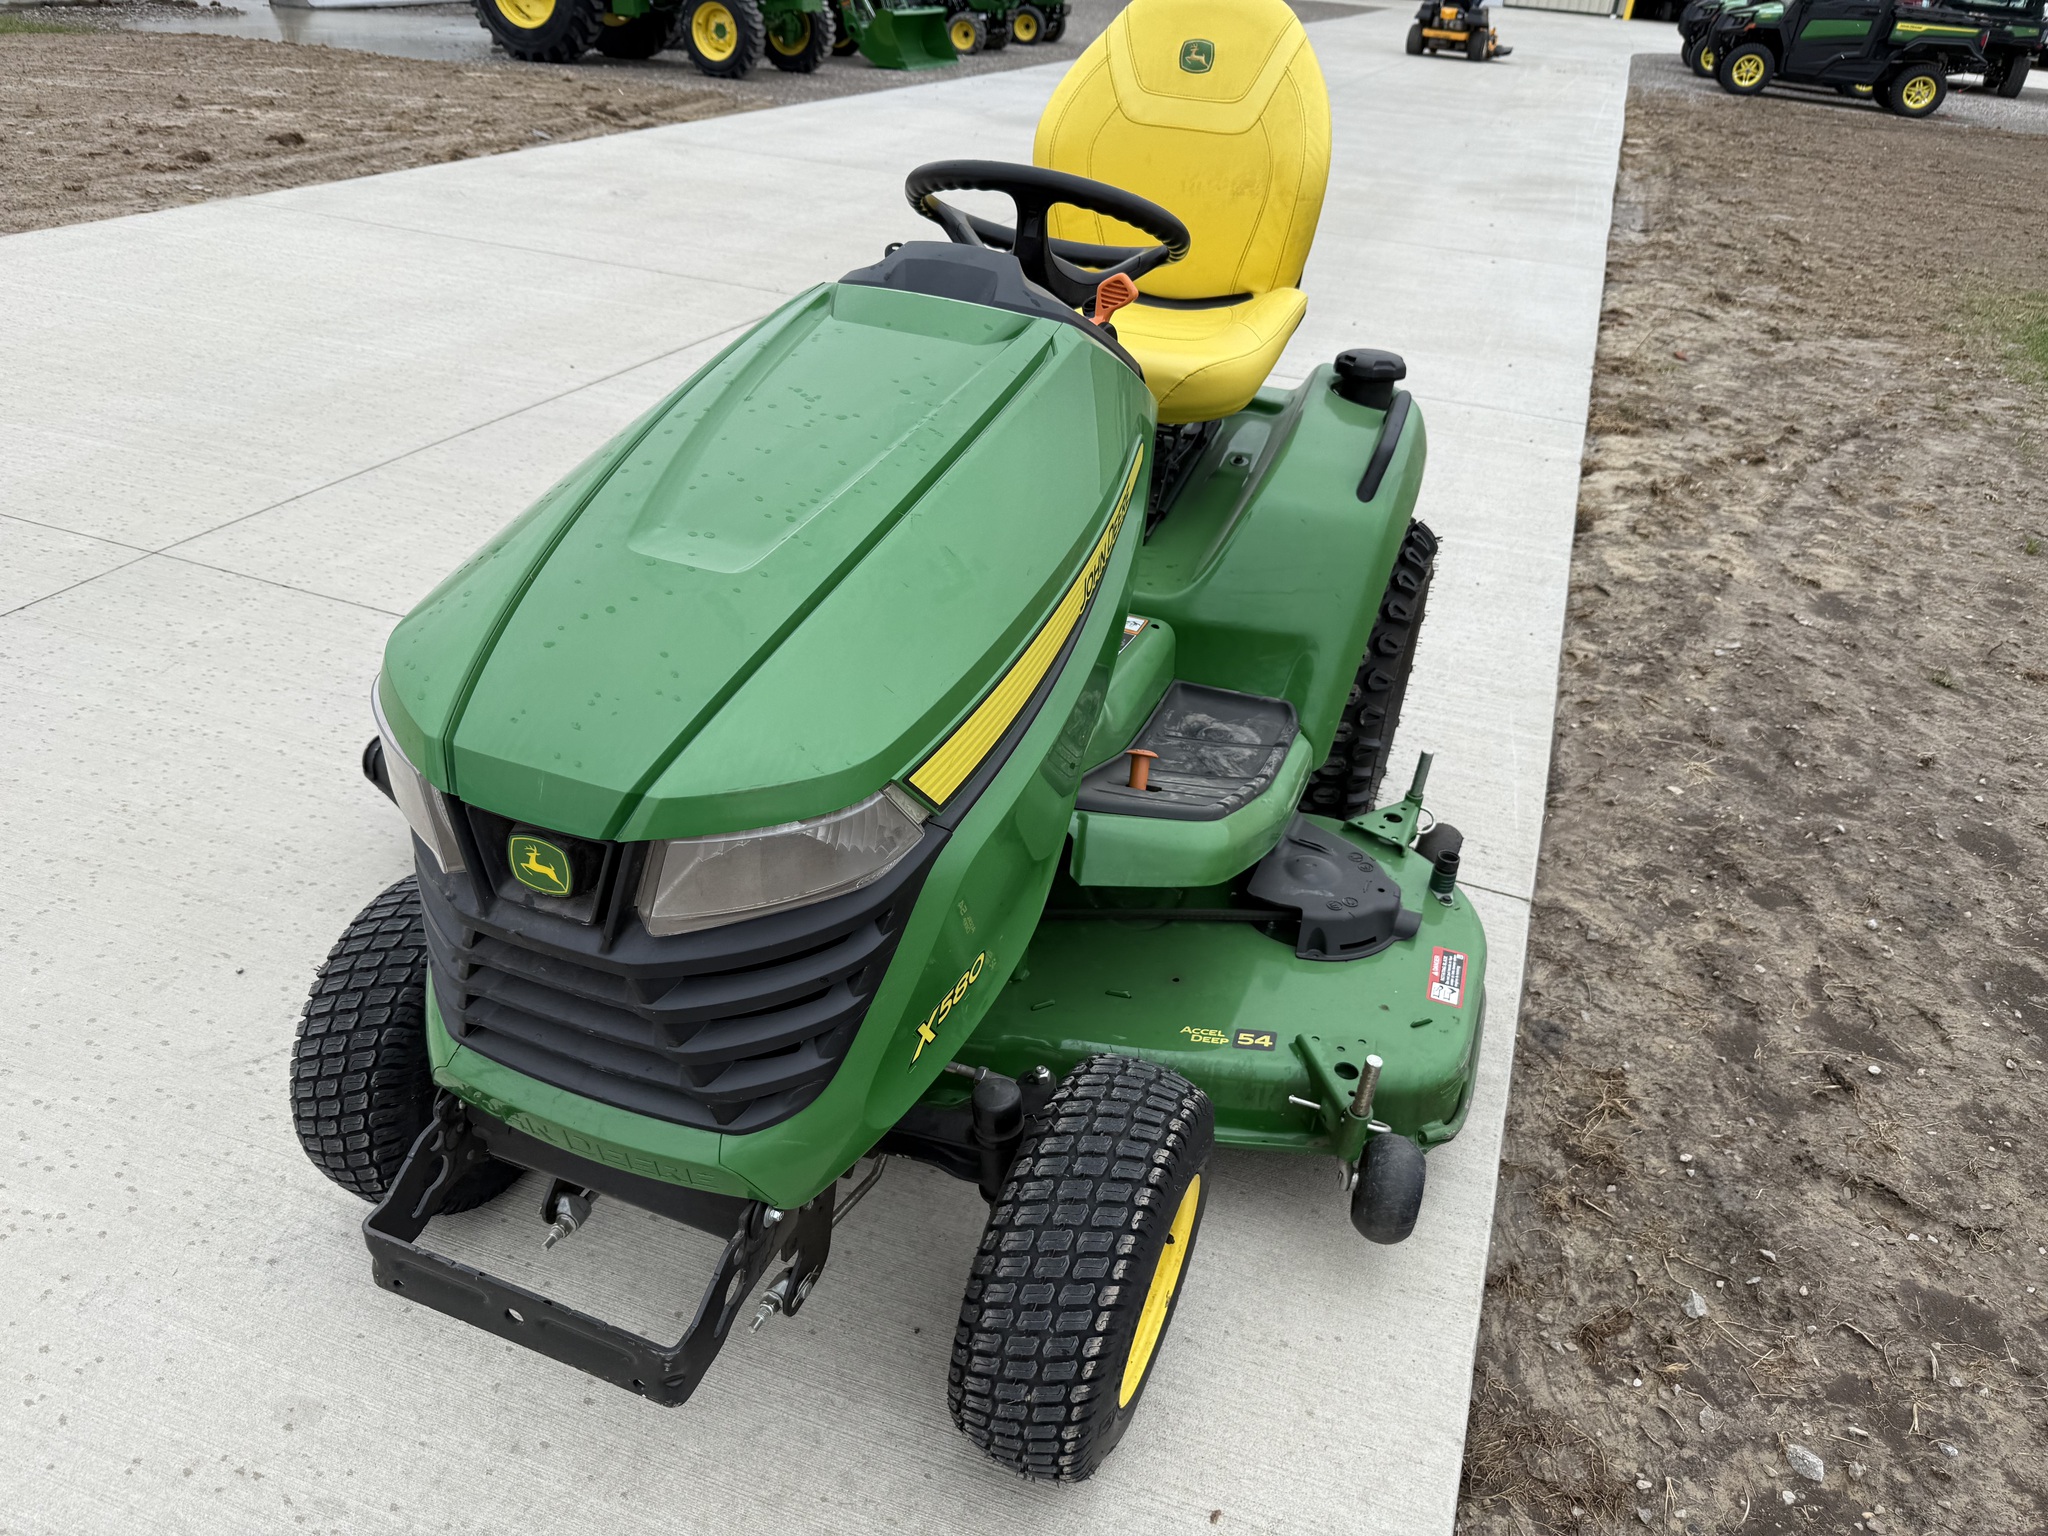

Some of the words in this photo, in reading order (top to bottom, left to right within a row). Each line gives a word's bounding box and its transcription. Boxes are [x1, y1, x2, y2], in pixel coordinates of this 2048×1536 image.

[1080, 541, 1107, 614] JOHN
[909, 951, 986, 1067] X580
[1180, 1026, 1226, 1038] ACCEL
[1190, 1034, 1230, 1045] DEEP
[1237, 1032, 1274, 1048] 54
[563, 1130, 721, 1189] DEERE
